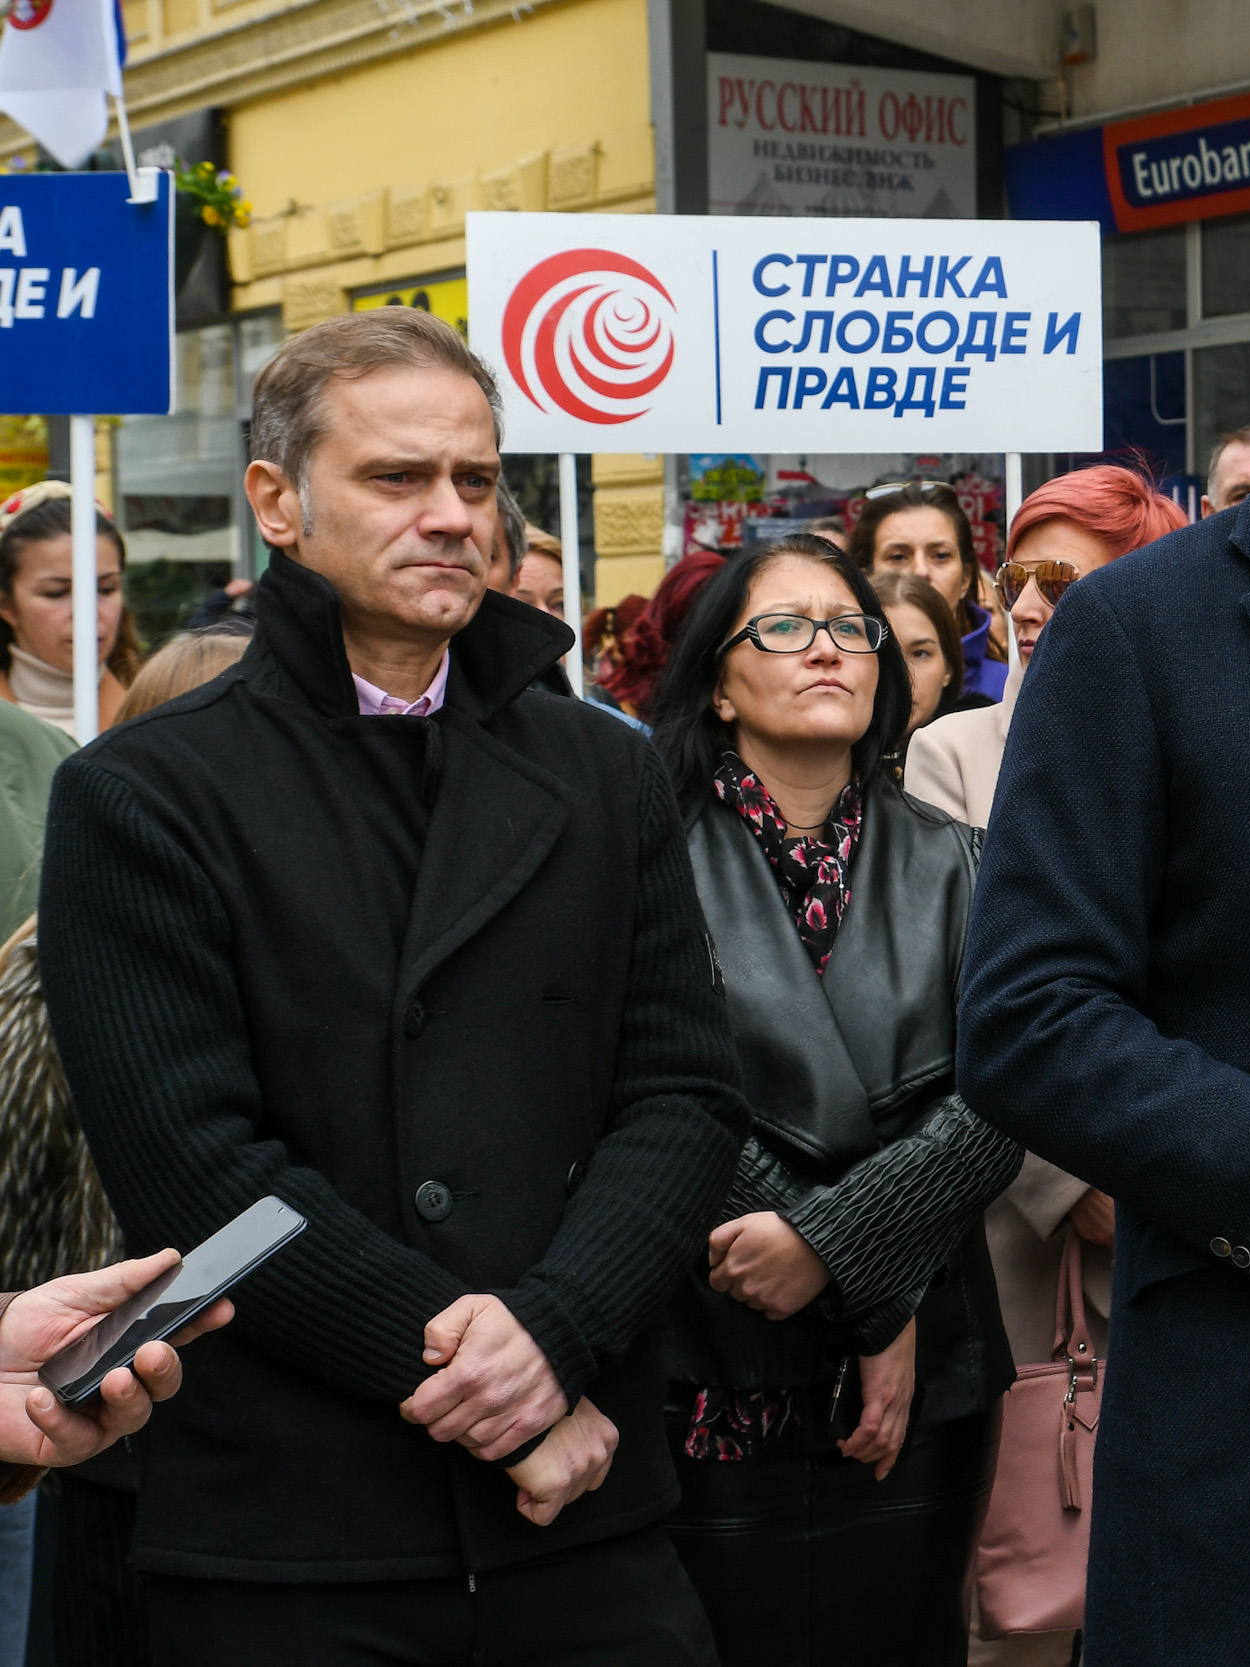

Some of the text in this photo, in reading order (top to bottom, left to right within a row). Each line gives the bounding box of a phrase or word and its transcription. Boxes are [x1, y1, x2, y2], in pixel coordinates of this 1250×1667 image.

[718, 76, 967, 147] РУССКИЙ ОФИС
[753, 138, 936, 171] НЕДВИЖИМОСТЬ
[57, 267, 101, 319] И
[752, 252, 1008, 299] СТРАНКА
[754, 309, 1082, 362] СЛОБОДЕ И
[754, 366, 971, 418] ПРАВДЕ
